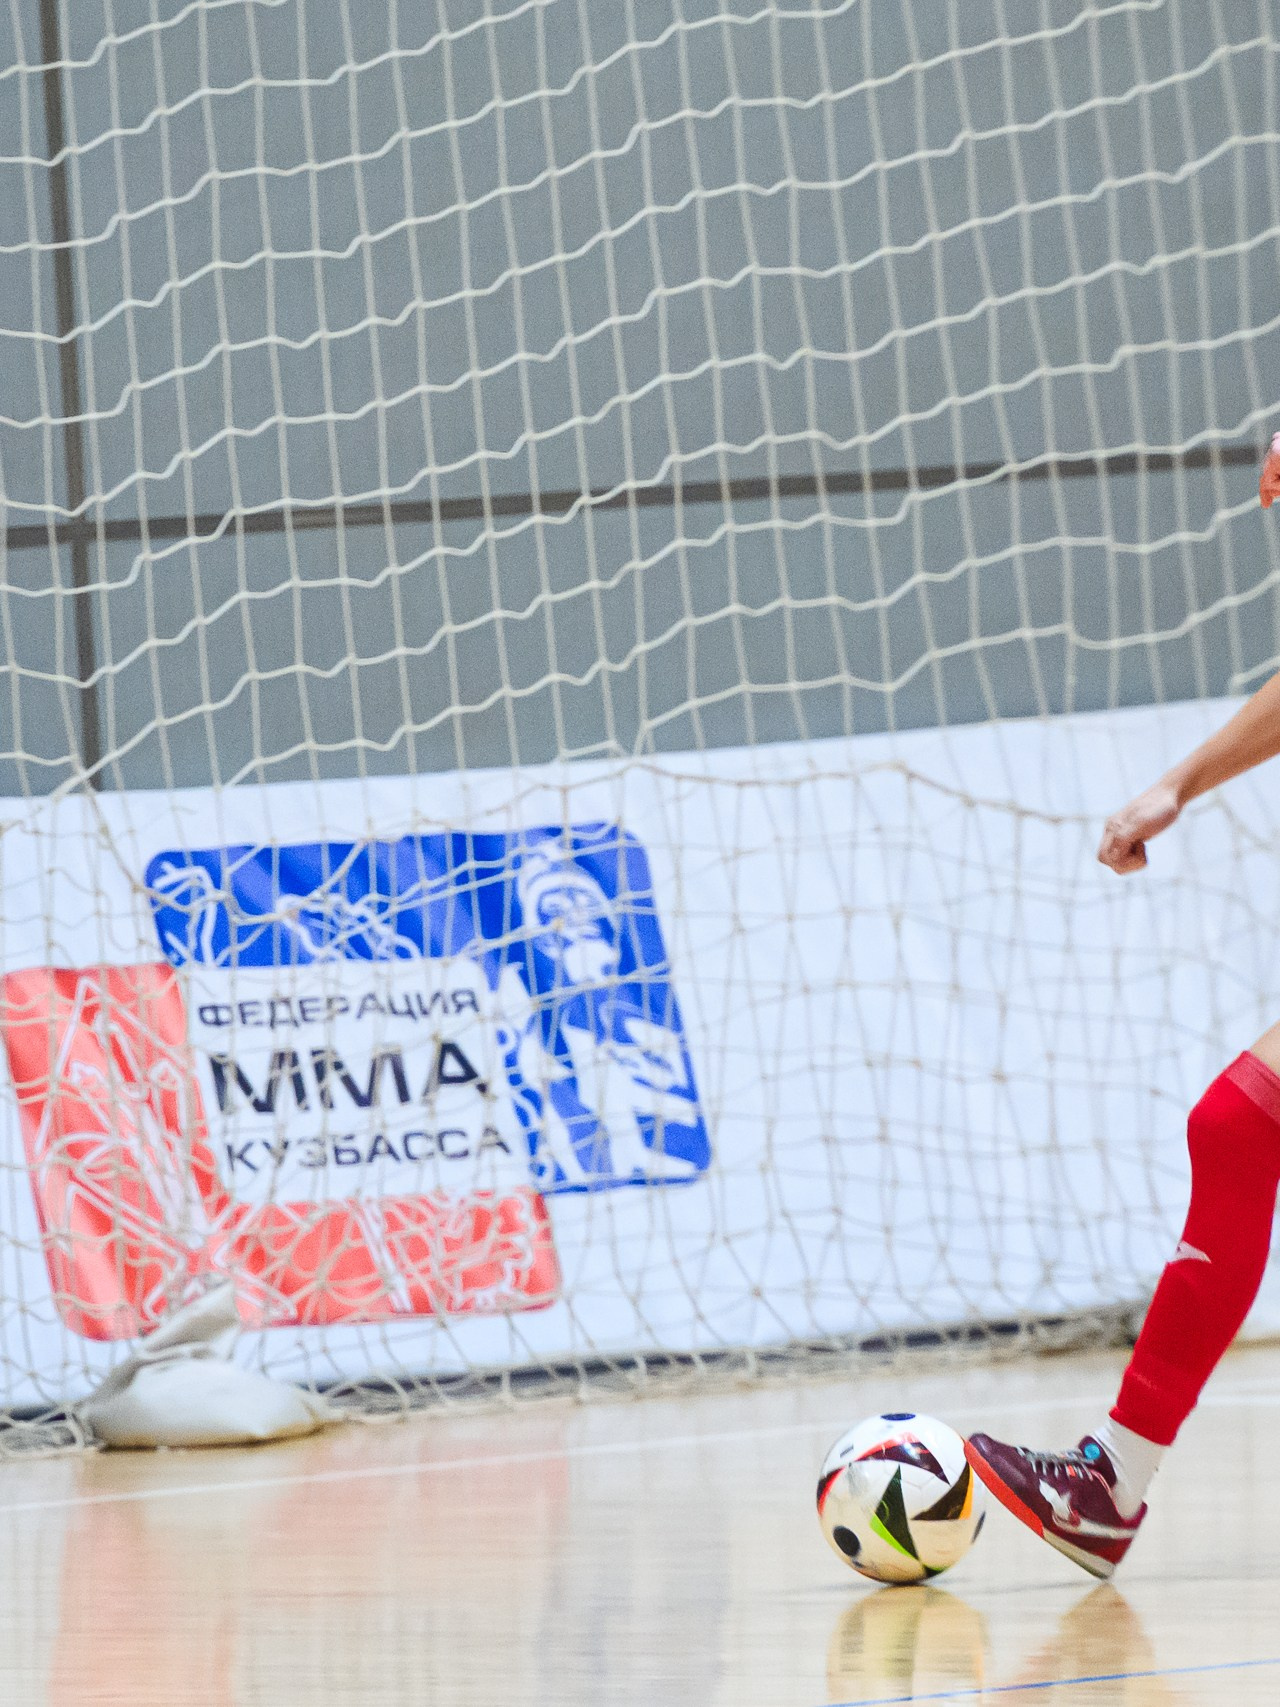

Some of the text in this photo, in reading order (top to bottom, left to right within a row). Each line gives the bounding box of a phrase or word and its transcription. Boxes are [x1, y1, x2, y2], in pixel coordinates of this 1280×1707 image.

[199, 988, 480, 1030] ФЕДЕРАЦИЯ
[209, 1042, 491, 1113] ММА
[225, 1126, 512, 1172] КУЗБАССА
